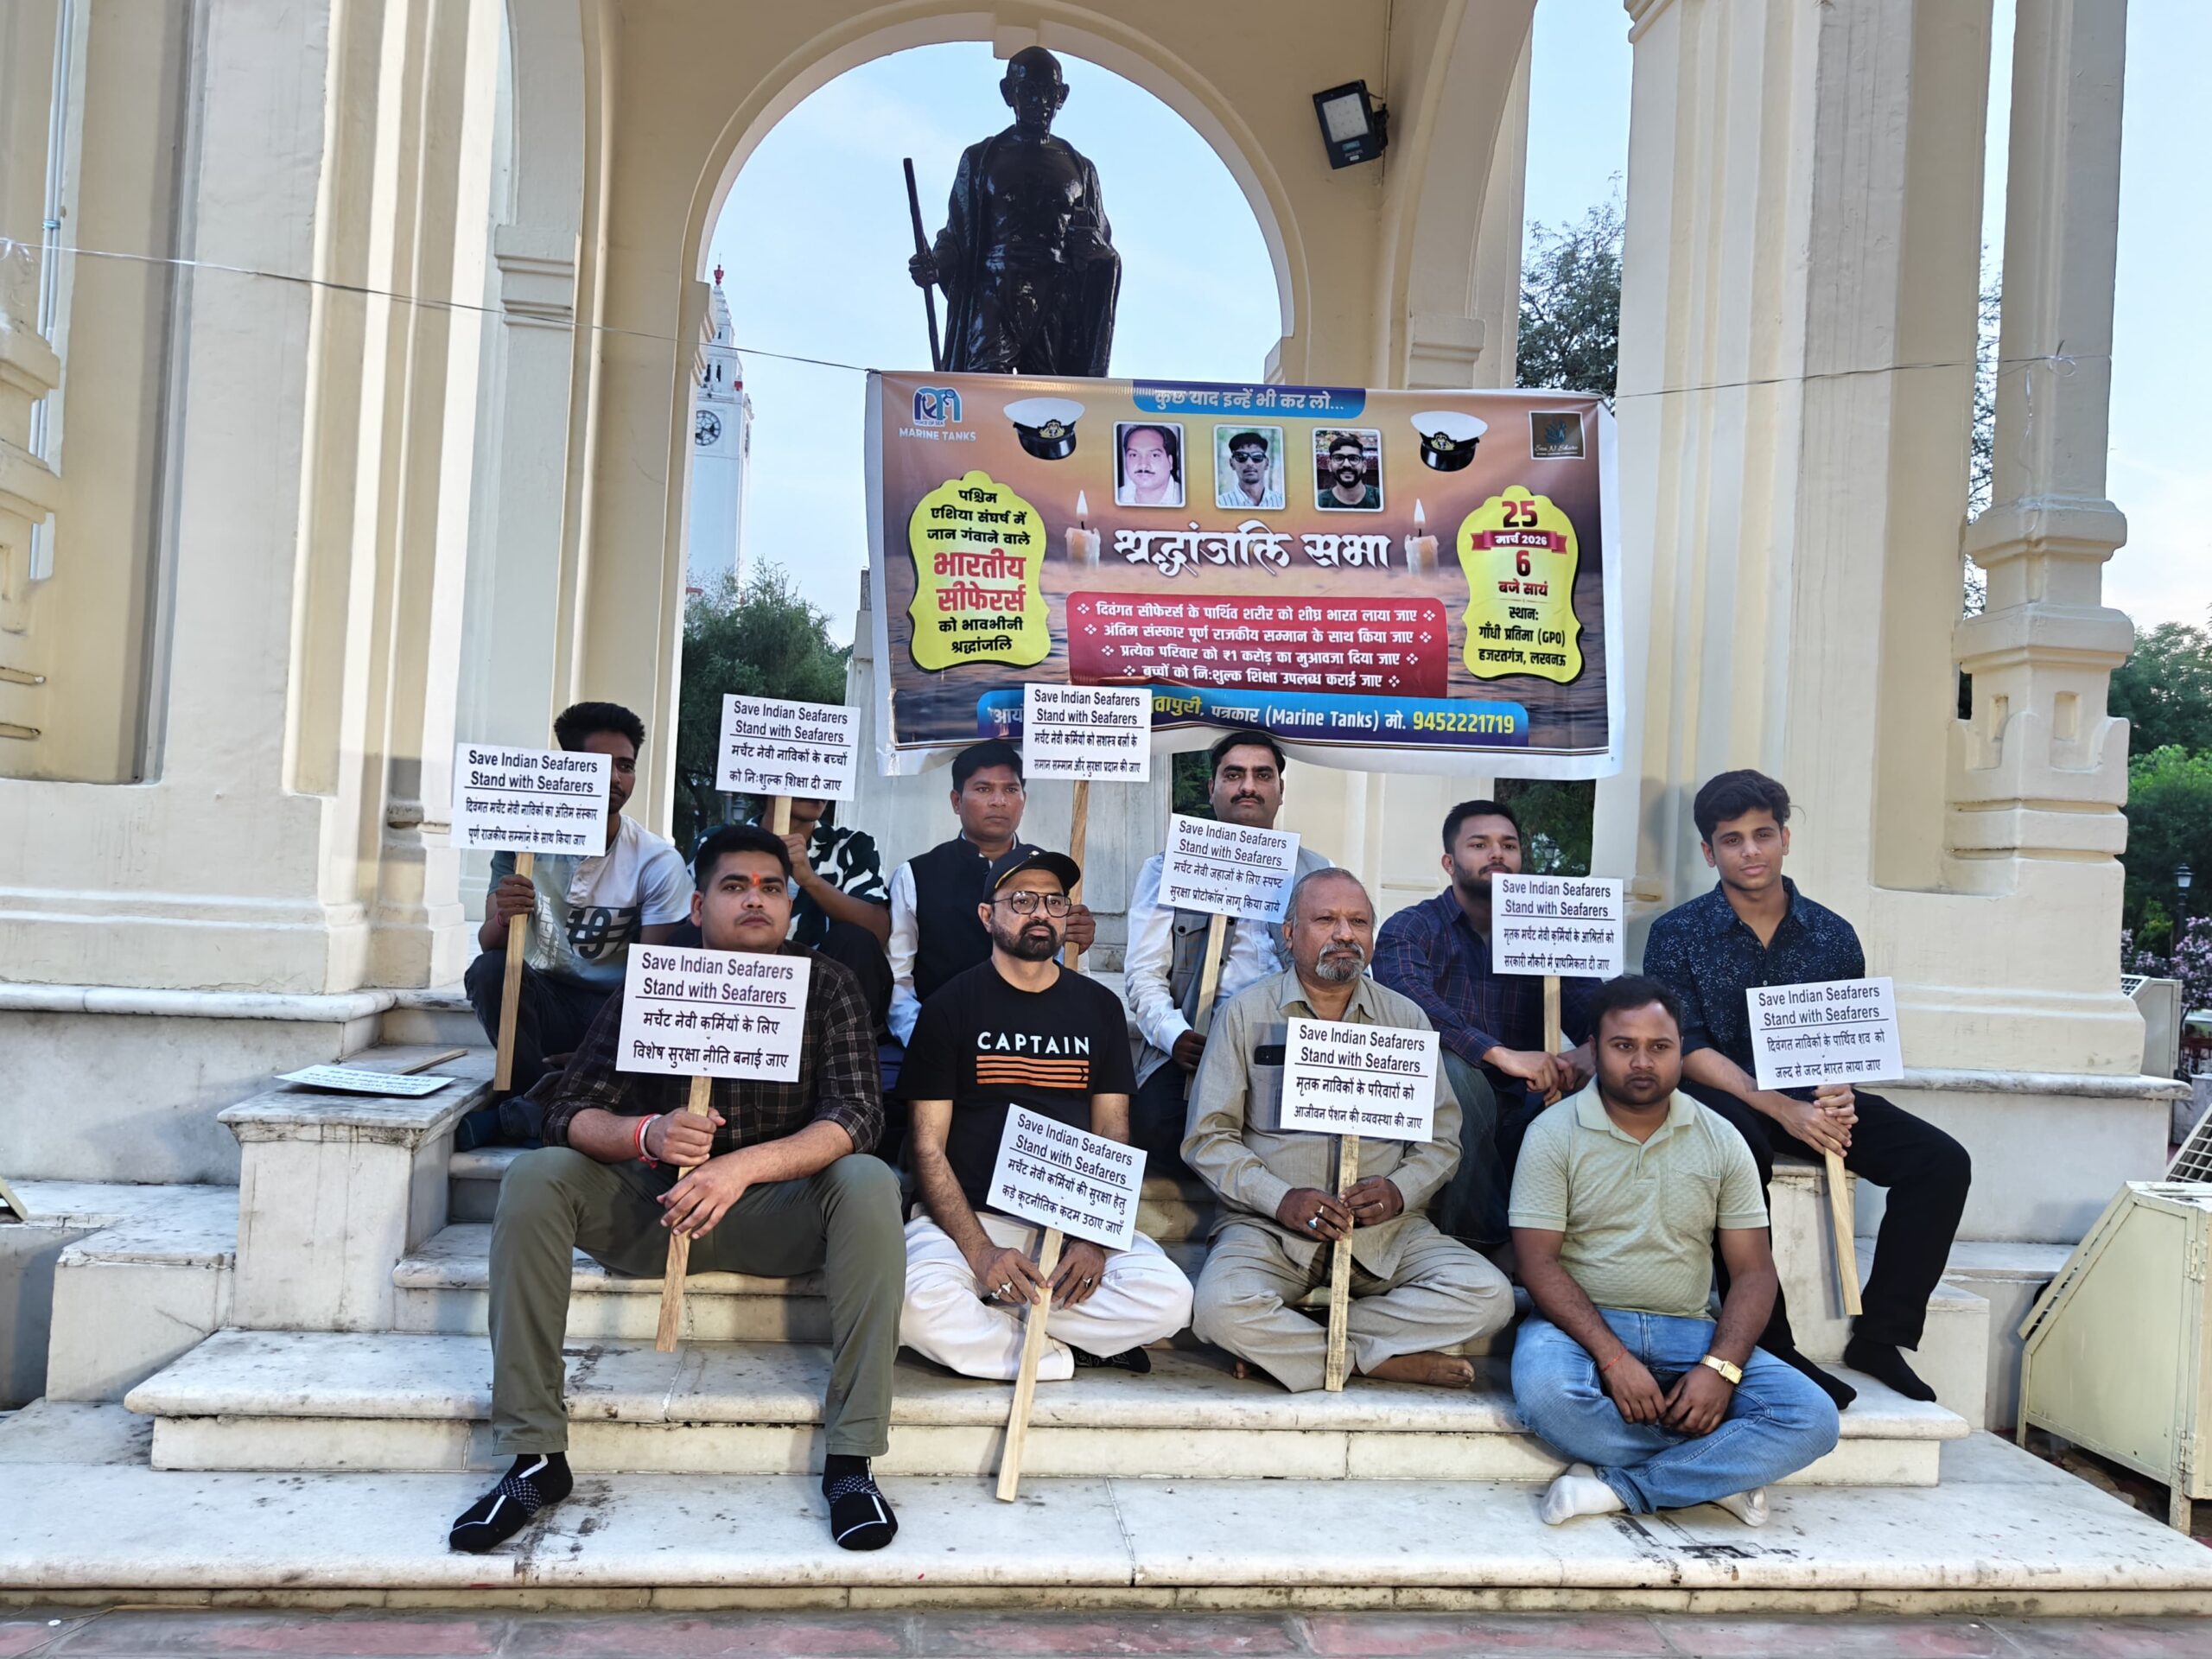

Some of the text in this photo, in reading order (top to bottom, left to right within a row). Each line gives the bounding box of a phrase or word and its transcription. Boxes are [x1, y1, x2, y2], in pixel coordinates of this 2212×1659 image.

[1154, 390, 1185, 410] कुछ
[1189, 391, 1219, 407] याद
[1224, 388, 1253, 409] इन्हें
[1256, 389, 1275, 408] भी
[1281, 394, 1305, 409] कर
[899, 428, 976, 441] MARINE TANKS
[958, 488, 997, 504] पश्चिम
[931, 505, 1027, 525] एशिया संघर्ष में
[1502, 500, 1538, 528] 25
[927, 527, 1030, 545] जान गंवाने वाले
[1495, 532, 1548, 545] मार्च 2026
[1114, 520, 1391, 576] श्रद्धांजलि सभा
[934, 548, 1026, 579] भारतीय
[1516, 550, 1530, 577] 6
[937, 581, 1026, 612] सीफेरर्स
[1498, 578, 1548, 596] बजे सायं
[1096, 601, 1417, 622] दिवंगत सीफेरर्स के पार्थिव शरीर को शीघ्र भारत लाया जाए
[938, 616, 1023, 632] को भावभीनी
[1104, 622, 1414, 643] अंतिम संस्कार पूर्ण राजकीय सम्मान के साथ किया जाए
[951, 635, 1013, 653] श्रद्धांजलि
[1505, 625, 1534, 642] प्रतिमा
[1538, 630, 1565, 646] (GPO)
[1120, 643, 1154, 657] प्रत्येक
[1158, 645, 1198, 659] परिवार
[1201, 646, 1218, 661] को
[1276, 651, 1292, 664] का
[1296, 652, 1344, 668] मुआवजा
[1347, 649, 1373, 664] दिया
[1376, 653, 1400, 664] जाए
[1478, 647, 1567, 666] हजरतगंज, लखनऊ
[1142, 664, 1170, 677] बच्चों
[1173, 666, 1189, 679] को
[1245, 668, 1277, 683] शिक्षा
[1281, 672, 1321, 685] उपलब्ध
[1325, 671, 1356, 688] कराई
[1360, 674, 1382, 687] जाए
[1034, 689, 1140, 706] Save Indian Seafarers
[734, 701, 848, 724] Save Indian Seafarers
[1037, 709, 1065, 722] Stand
[1067, 710, 1088, 722] with
[1090, 711, 1137, 725] Seafarers
[1211, 705, 1260, 722] पत्रकार
[1266, 705, 1325, 728] (Marine
[1330, 710, 1379, 732] Tanks)
[1385, 710, 1407, 729] मो.
[1413, 711, 1515, 734] 9452221719
[735, 720, 844, 743] Stand with Seafarers
[468, 750, 598, 772] Save Indian Seafarers
[471, 771, 594, 792] Stand with Seafarers
[1179, 820, 1287, 849] Save Indian Seafarers
[1179, 838, 1282, 867] Stand with Seafarers
[1503, 879, 1611, 898] Save Indian Seafarers
[1505, 899, 1609, 917] Stand with Seafarers
[642, 952, 793, 980] Save Indian Seafarers
[643, 977, 787, 1004] Stand with Seafarers
[1758, 985, 1880, 1007] Save Indian Seafarers
[675, 1011, 697, 1030] नेवी
[701, 1013, 740, 1032] कर्मियों
[742, 1015, 753, 1033] के
[757, 1015, 780, 1034] लिए
[1764, 1007, 1879, 1027] Stand with Seafarers
[976, 1032, 1090, 1055] CAPTAIN
[1300, 1025, 1425, 1052] Save Indian Seafarers
[633, 1039, 789, 1069] विशेष सुरक्षा नीति बनाई जाए
[1300, 1046, 1421, 1073] Stand with Seafarers
[1775, 1058, 1881, 1078] जल्द से जल्द भारत लाया जाए
[1018, 1113, 1133, 1166] Save Indian Seafarers
[1016, 1135, 1127, 1185] Stand with Seafarers
